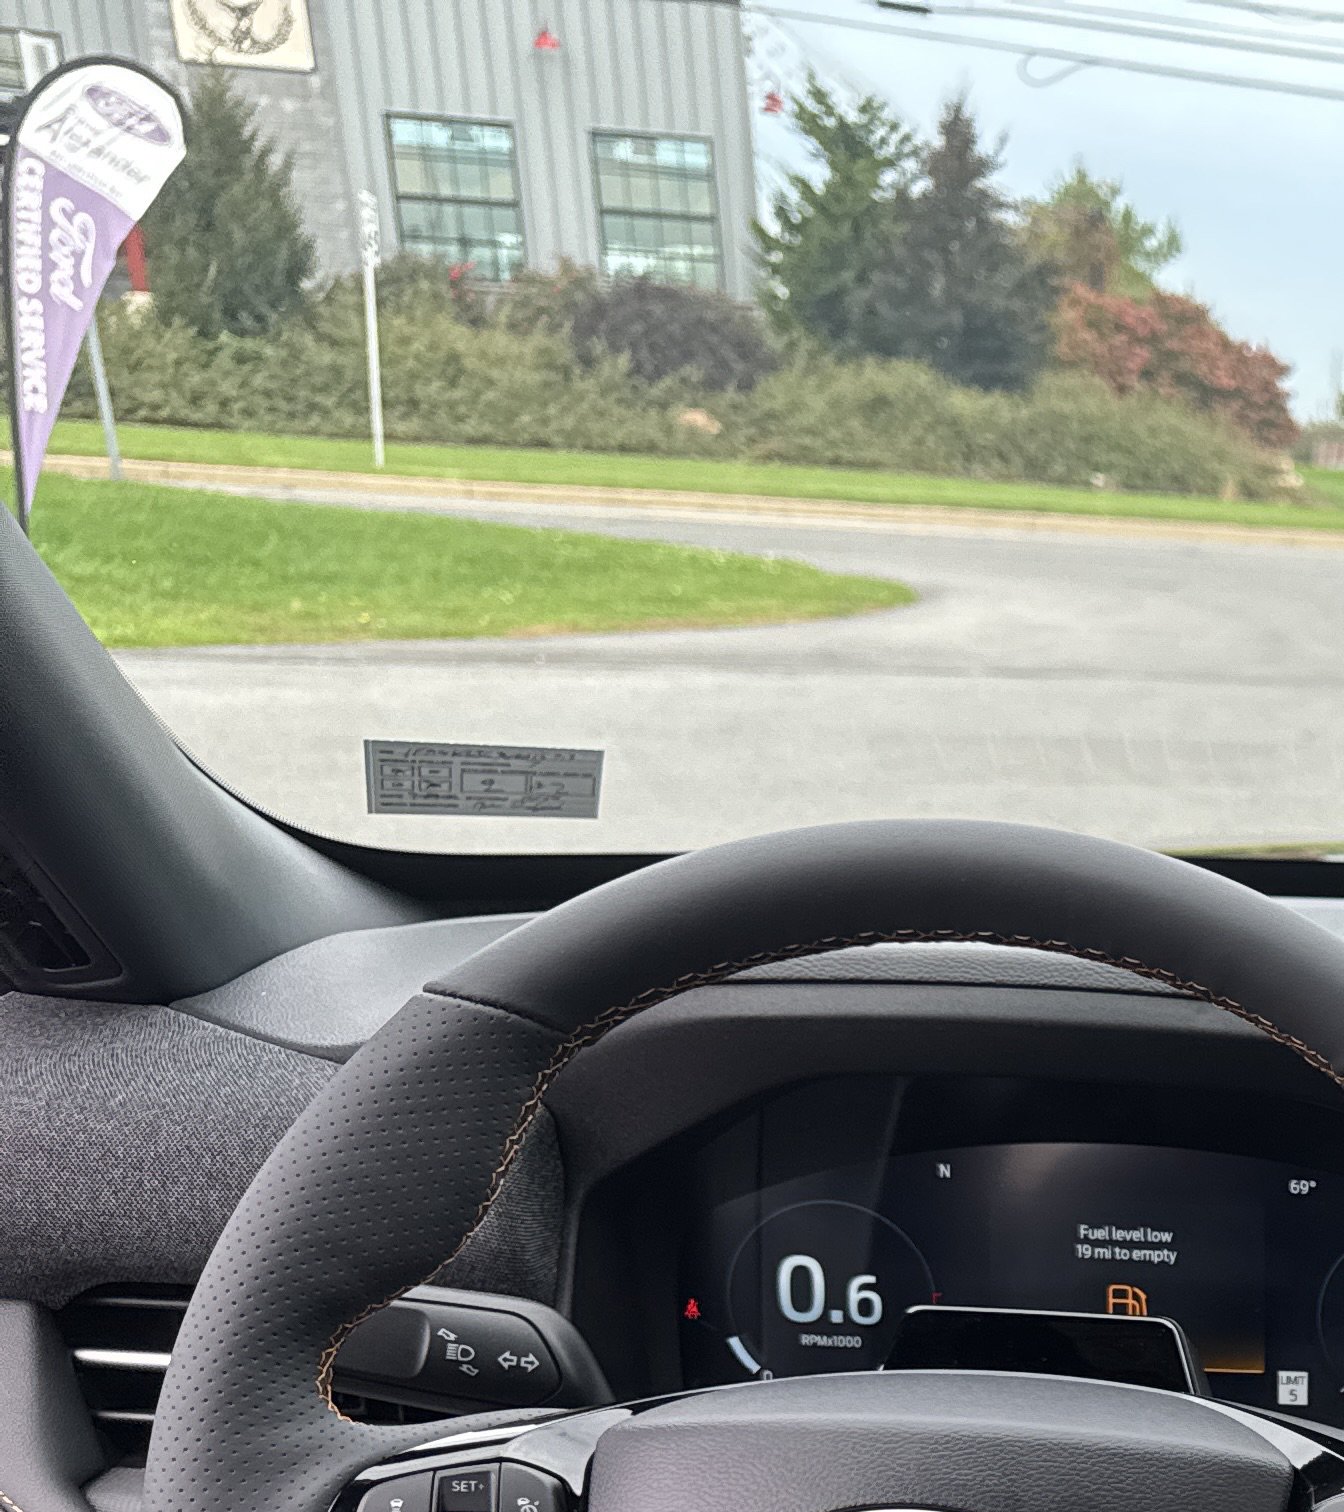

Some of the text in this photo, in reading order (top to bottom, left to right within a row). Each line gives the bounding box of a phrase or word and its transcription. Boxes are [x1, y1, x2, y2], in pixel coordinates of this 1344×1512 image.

[50, 197, 96, 311] Ford
[16, 157, 48, 414] CERTIFIED SERVICE
[936, 1163, 952, 1179] N
[1288, 1178, 1317, 1195] 69°
[1079, 1223, 1174, 1243] Fuel level low
[1075, 1243, 1178, 1265] 19 mi to empty
[776, 1254, 883, 1326] 0.6
[800, 1334, 863, 1349] RPMx1000
[1280, 1375, 1307, 1386] LIMIT
[1289, 1389, 1298, 1402] 5
